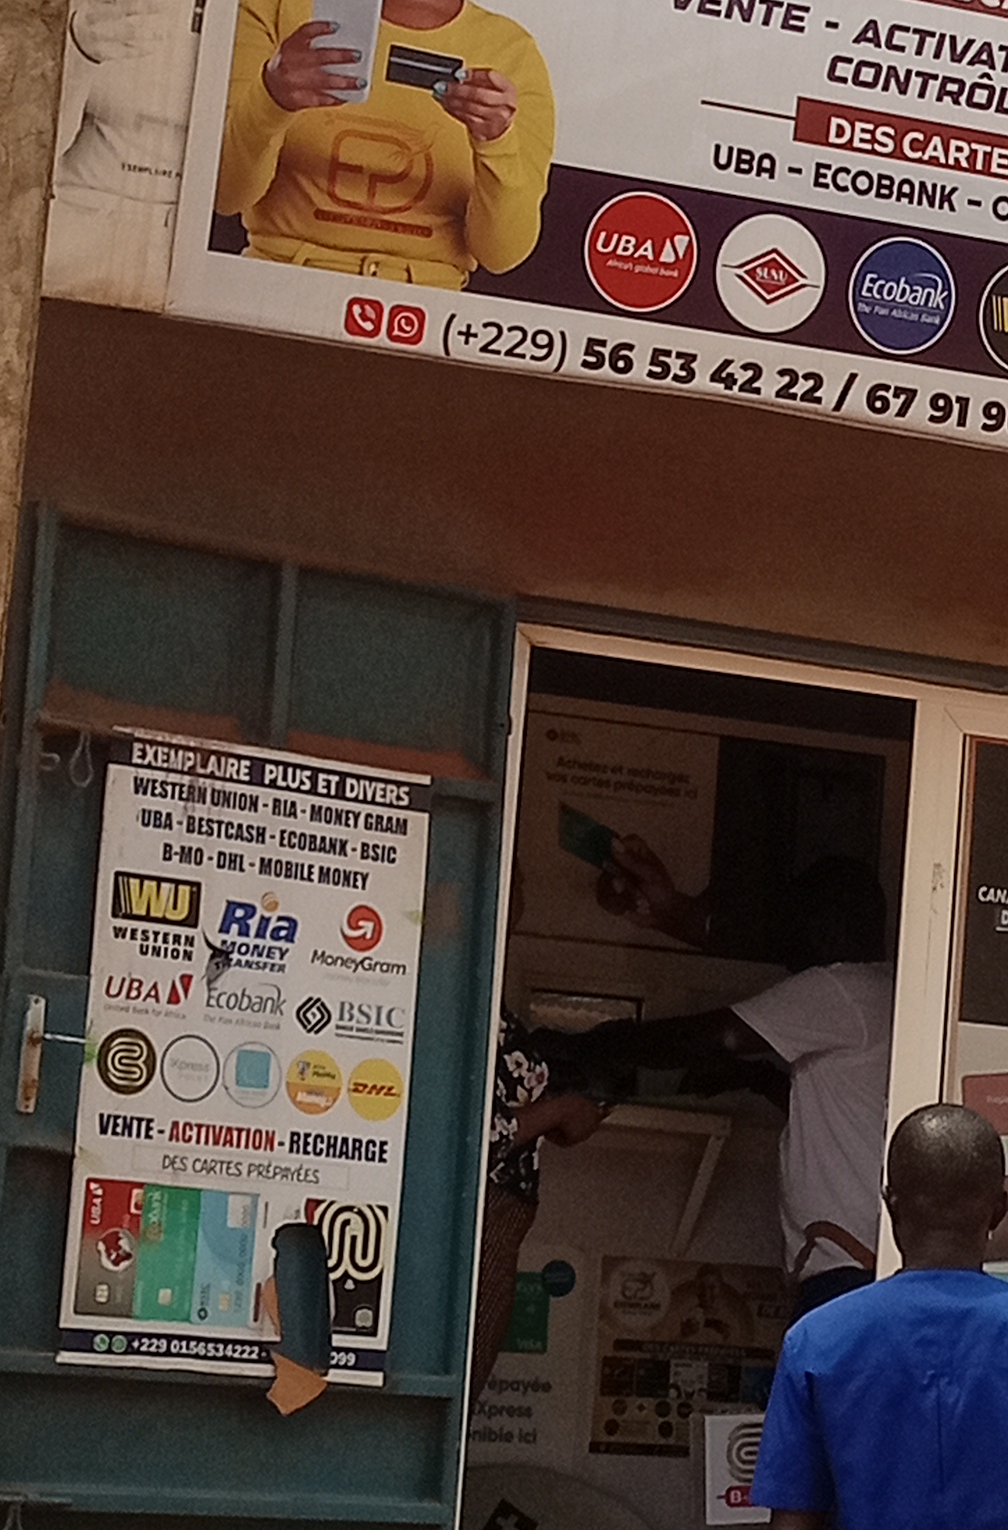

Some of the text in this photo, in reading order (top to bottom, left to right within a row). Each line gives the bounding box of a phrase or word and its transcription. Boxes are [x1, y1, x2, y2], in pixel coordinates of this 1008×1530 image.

[828, 116, 895, 155] DES
[713, 143, 778, 182] UBA
[812, 160, 958, 213] ECOBANK
[596, 230, 655, 261] UBA
[861, 272, 949, 311] Ecobank
[442, 313, 568, 372] (+229)
[581, 337, 635, 375] 56
[646, 346, 699, 385] 53
[709, 358, 763, 396] 42
[775, 368, 824, 405] 22
[832, 372, 858, 412] /
[865, 383, 918, 419] 67
[928, 392, 970, 428] 91
[132, 742, 410, 806] EXEMPLAIRE PLUS ET DIVERS
[133, 776, 408, 836] WESTERN UNION RIA MONEY GRAM
[141, 809, 397, 864] UBA BESTCASH ECOBANK BSIC
[162, 842, 369, 891] B-MO DHL MOBILE MONEY
[120, 876, 191, 922] WU
[218, 891, 298, 944] Ria
[112, 925, 195, 948] WESTERN
[139, 943, 193, 962] UNION
[311, 949, 406, 976] MoneyGram
[105, 975, 160, 1002] UBA
[206, 982, 286, 1017] Ecobank
[338, 1000, 406, 1030] BSIC
[352, 1082, 397, 1098] DHL
[99, 1112, 388, 1164] VENTE ACTIVATION RECHARGE
[162, 1154, 187, 1172] DES
[192, 1157, 242, 1179] CARTES
[131, 1339, 167, 1354] +229
